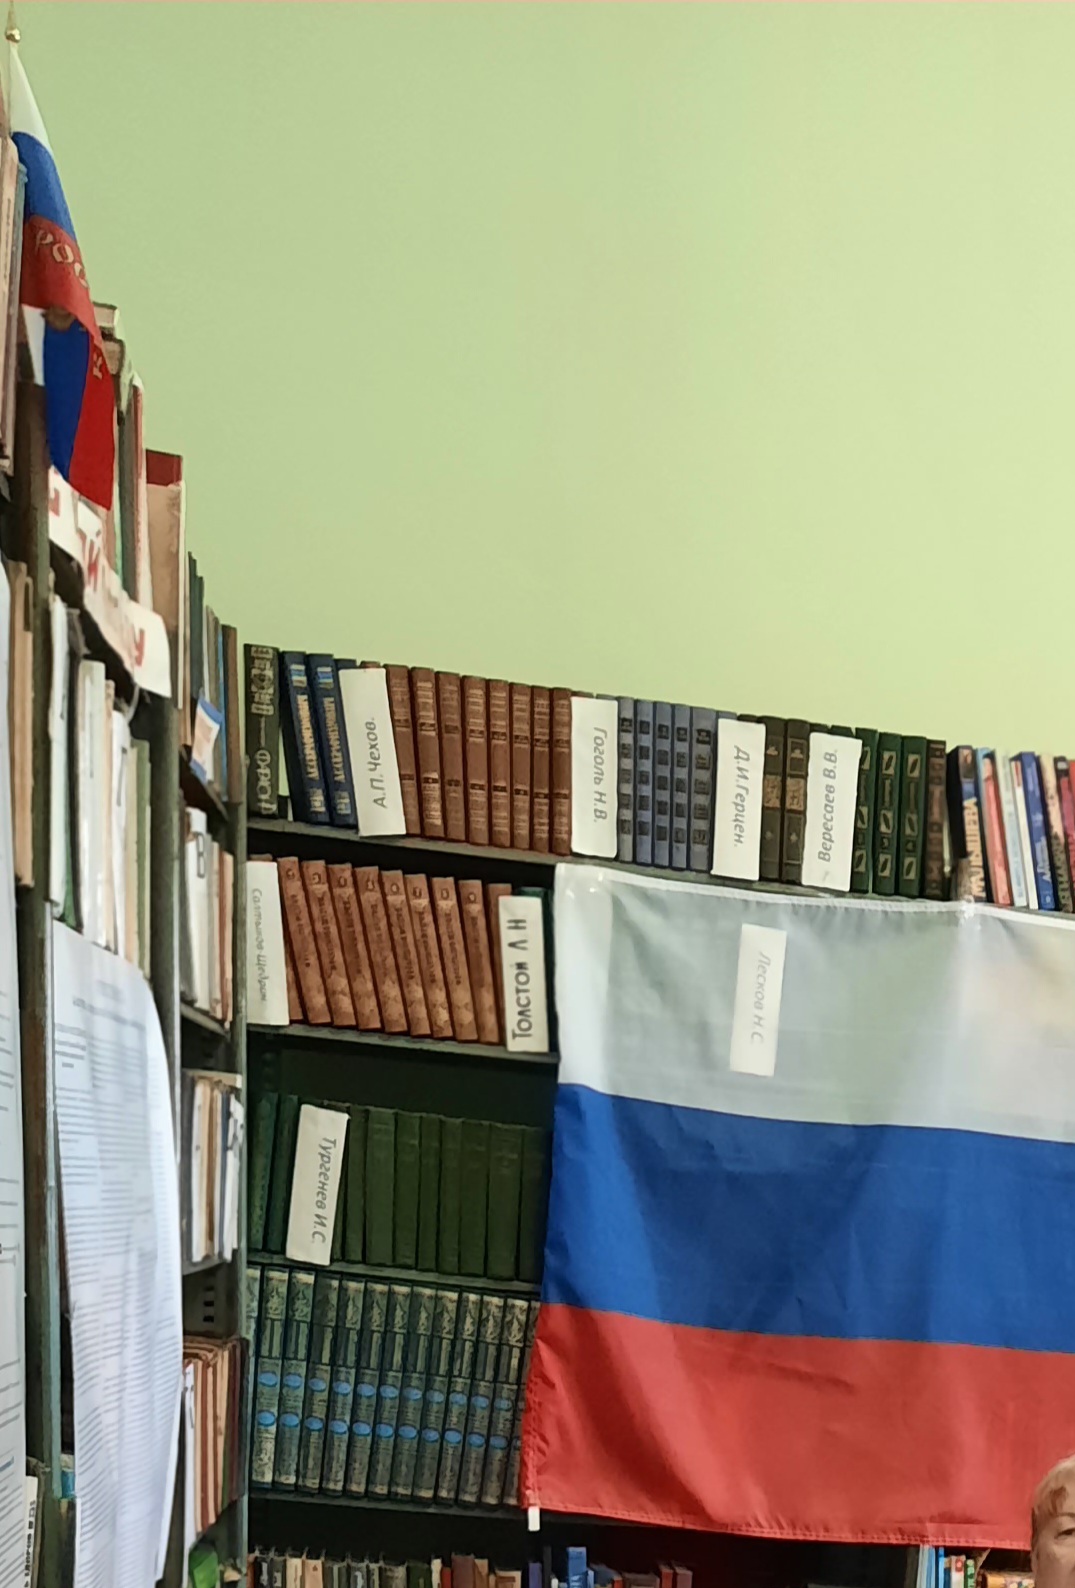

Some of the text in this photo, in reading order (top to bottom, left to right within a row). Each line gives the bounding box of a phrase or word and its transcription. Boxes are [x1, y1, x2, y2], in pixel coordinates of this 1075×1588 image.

[593, 726, 608, 824] Гоголь Н.В.
[818, 749, 838, 863] Вересаев В.В.
[754, 951, 771, 1011] Лесков
[315, 1137, 337, 1210] Тургенев
